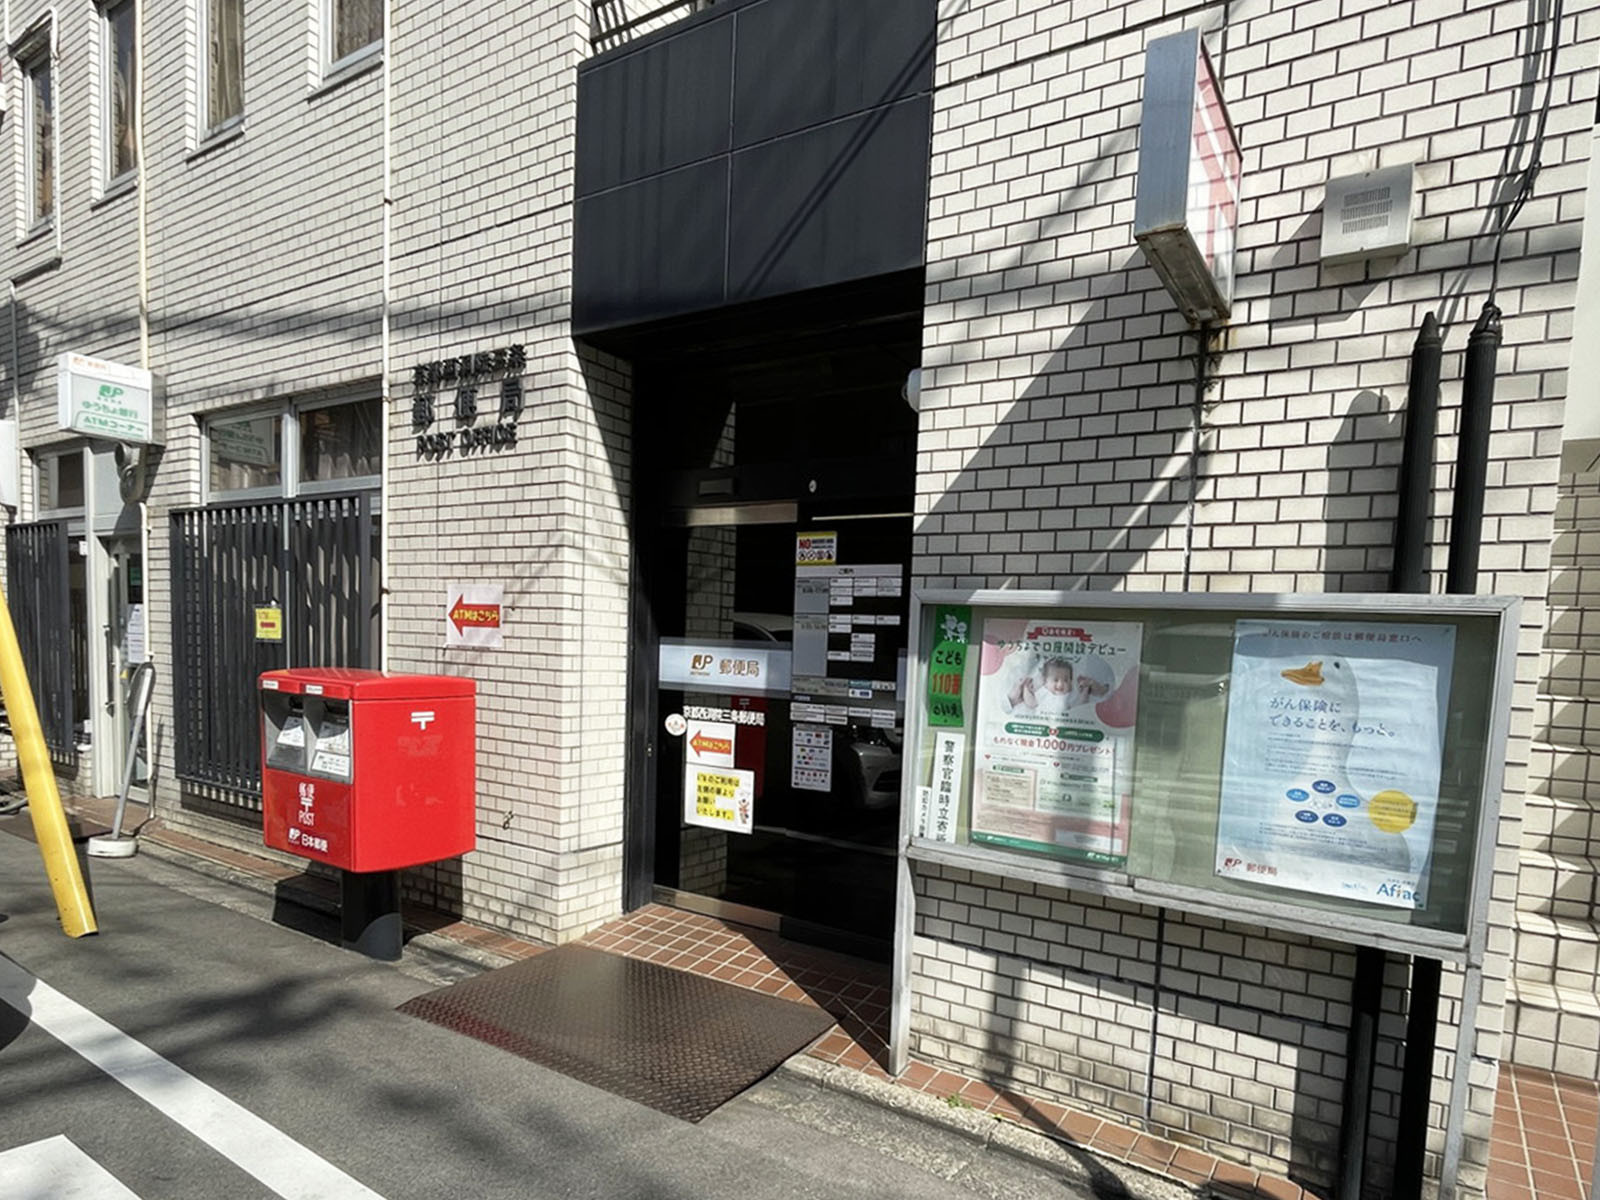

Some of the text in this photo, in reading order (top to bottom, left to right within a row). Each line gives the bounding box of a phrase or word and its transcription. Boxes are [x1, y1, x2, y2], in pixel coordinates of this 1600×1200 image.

[412, 377, 521, 421] 郵便局
[82, 401, 138, 419] ゆうちょ銀行
[84, 416, 144, 431] ATMコーナー
[416, 422, 518, 453] POST OFFICE
[799, 539, 812, 550] NO
[453, 609, 498, 622] ATMはこちら
[998, 639, 1126, 656] ゆうちょで口座開設デビュー
[935, 650, 962, 665] こども
[719, 658, 760, 677] 郵便局
[932, 672, 961, 696] 110番
[1270, 698, 1341, 714] がん保険に
[1269, 714, 1396, 738] できることを、もっと。
[299, 782, 315, 799] 郵便
[298, 809, 315, 826] POST
[301, 833, 328, 853] 日本郵便
[1246, 862, 1278, 876] 郵便局
